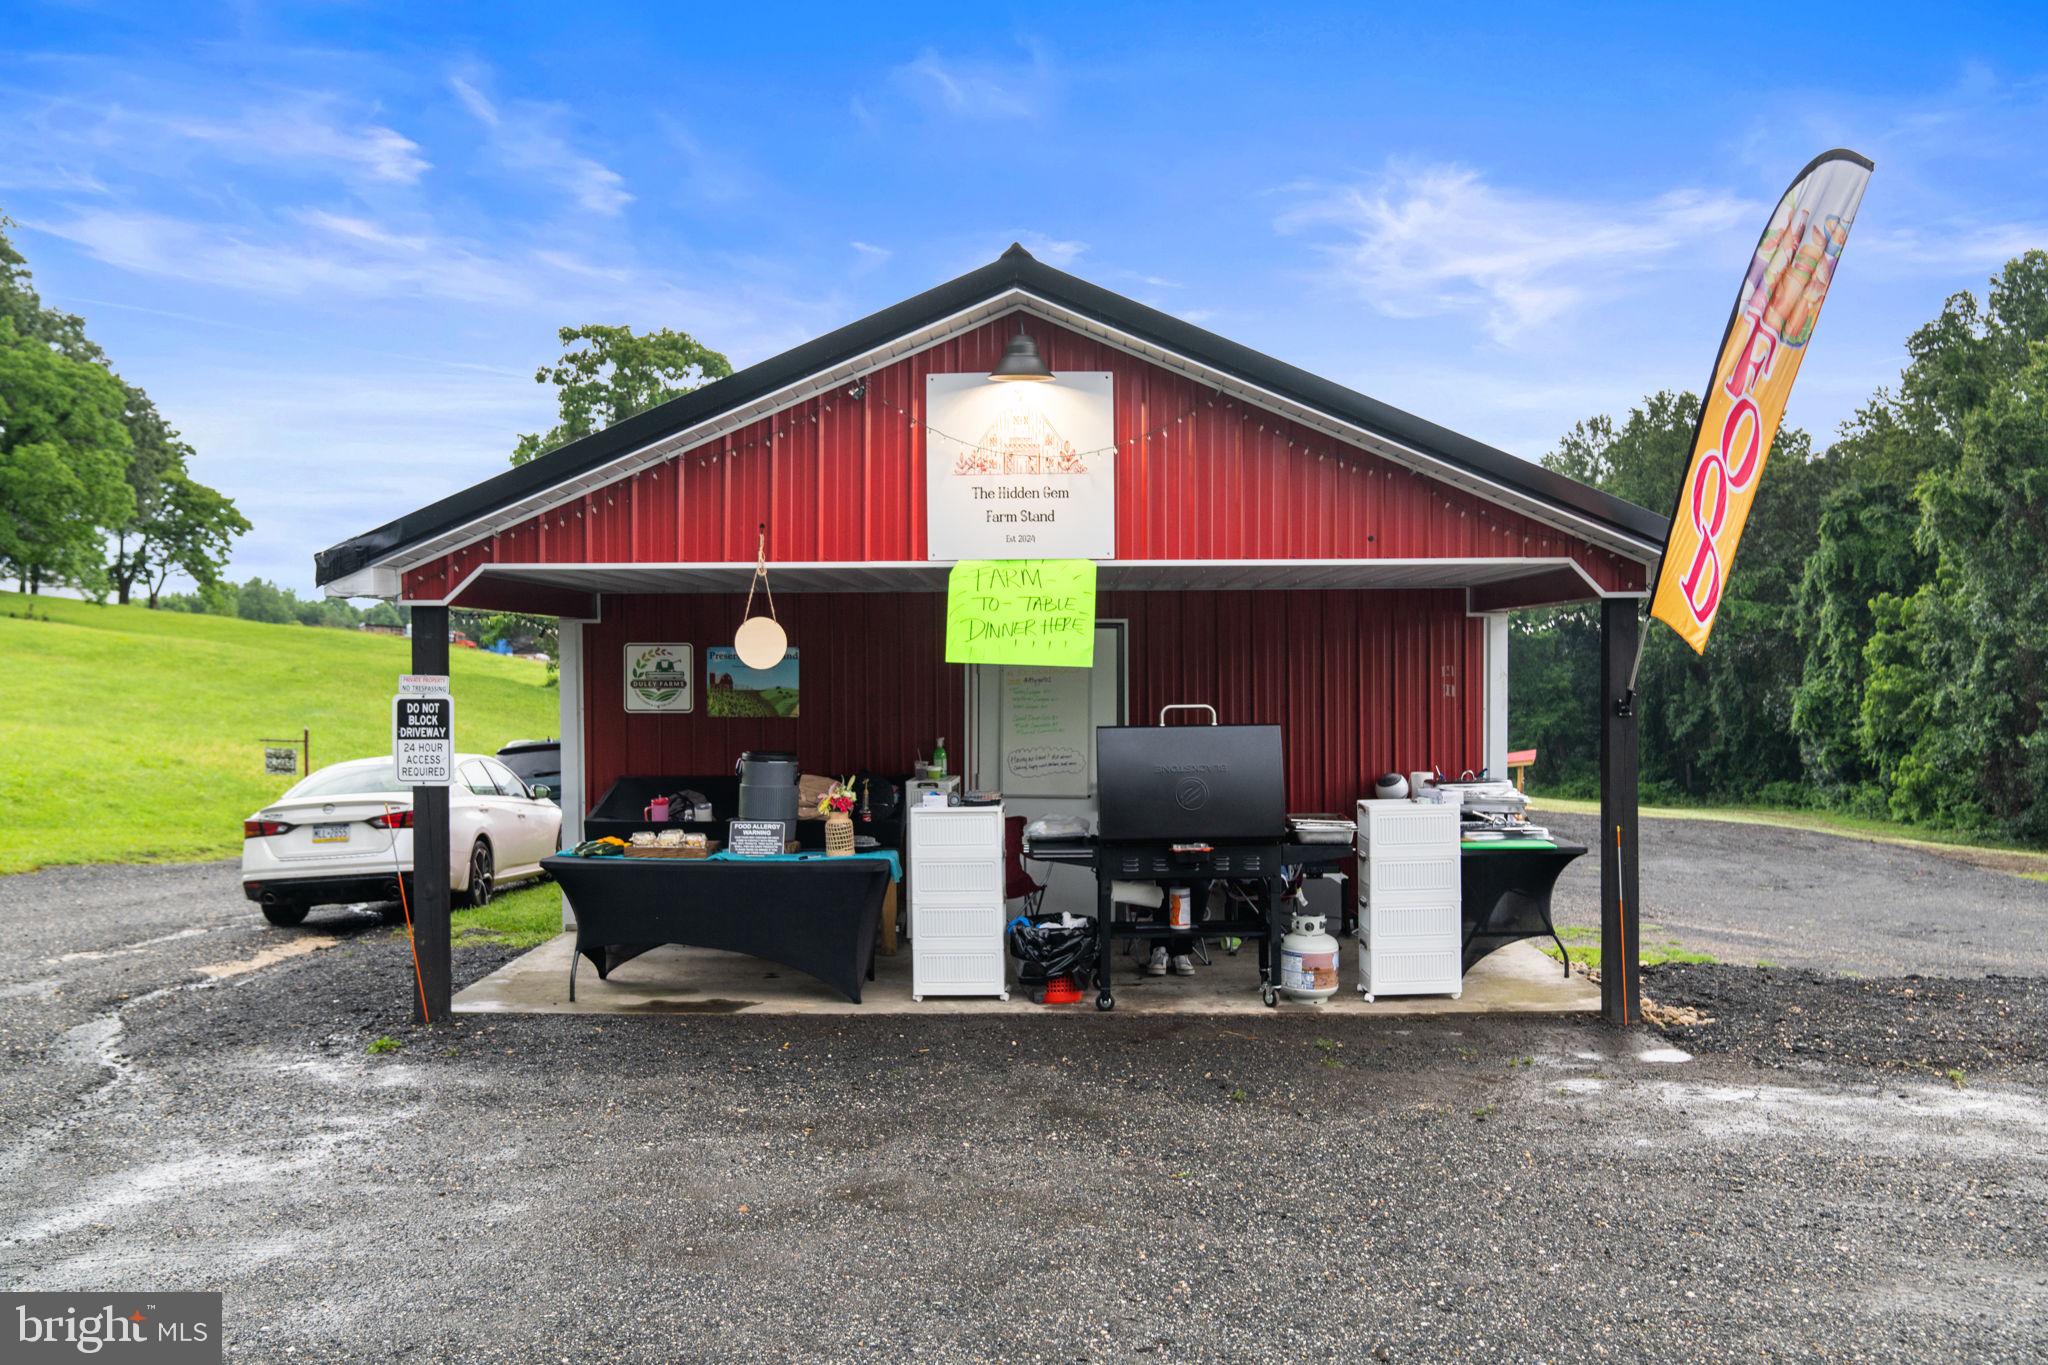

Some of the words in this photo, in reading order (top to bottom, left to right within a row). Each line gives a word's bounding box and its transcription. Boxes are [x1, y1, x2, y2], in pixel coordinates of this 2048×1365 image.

[1681, 307, 1779, 628] FOOD
[972, 486, 995, 500] The
[998, 486, 1040, 500] Hidden
[1043, 486, 1069, 500] Gem
[986, 509, 1017, 523] Farm
[1020, 509, 1055, 523] Stand
[1018, 534, 1036, 543] 2024
[1017, 596, 1077, 612] TABLE
[960, 618, 1037, 643] DINNER
[1040, 617, 1086, 637] HERE
[412, 685, 447, 693] TRESPASSING
[633, 681, 657, 689] DULEY
[406, 702, 420, 713] DO
[422, 702, 440, 713] NOT
[408, 715, 438, 725] BLOCK
[400, 727, 447, 737] DRIVEWAY
[403, 743, 415, 752] 24
[418, 743, 443, 752] HOUR
[406, 755, 441, 764] ACCESS
[402, 767, 446, 777] REQUIRED
